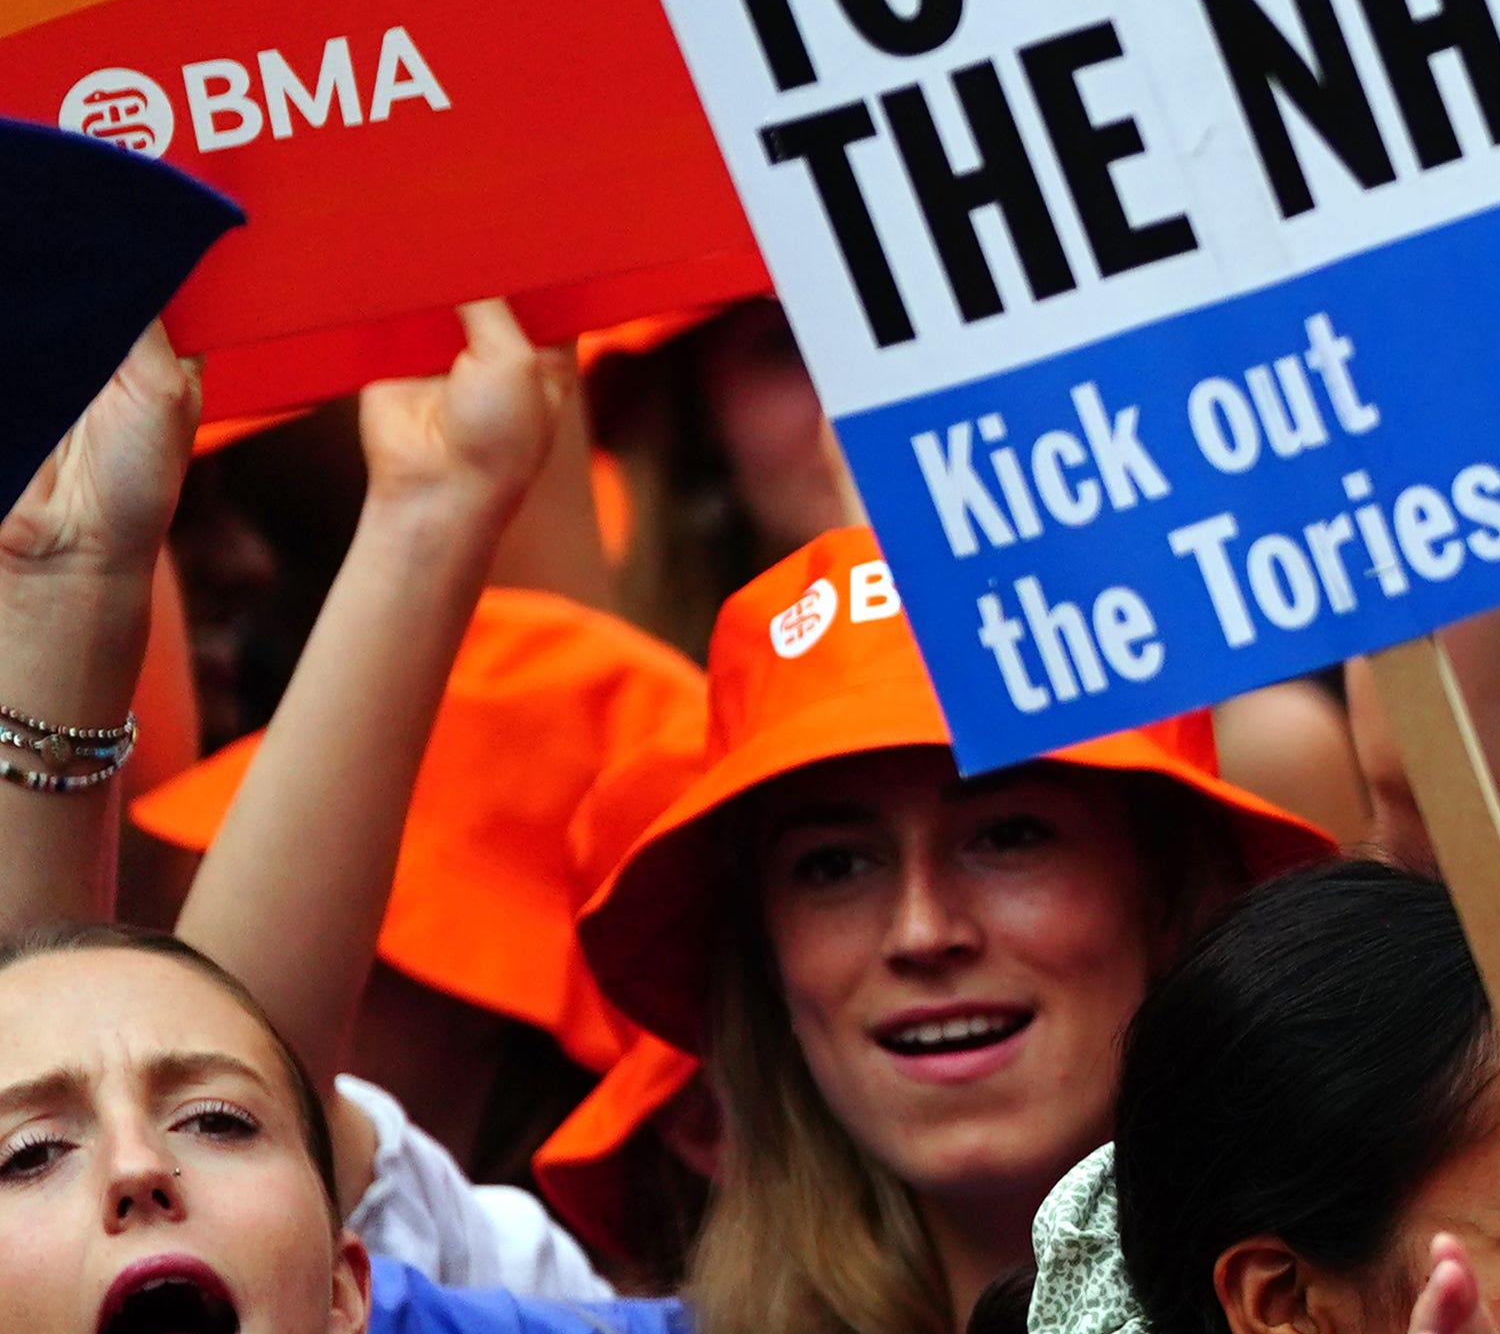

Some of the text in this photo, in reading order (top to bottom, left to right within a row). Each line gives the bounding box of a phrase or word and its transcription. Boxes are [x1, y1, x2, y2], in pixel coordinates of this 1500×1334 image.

[183, 26, 451, 153] BMA
[759, 20, 1201, 350] THE
[911, 310, 1381, 559] Kick out
[976, 575, 1166, 714] the
